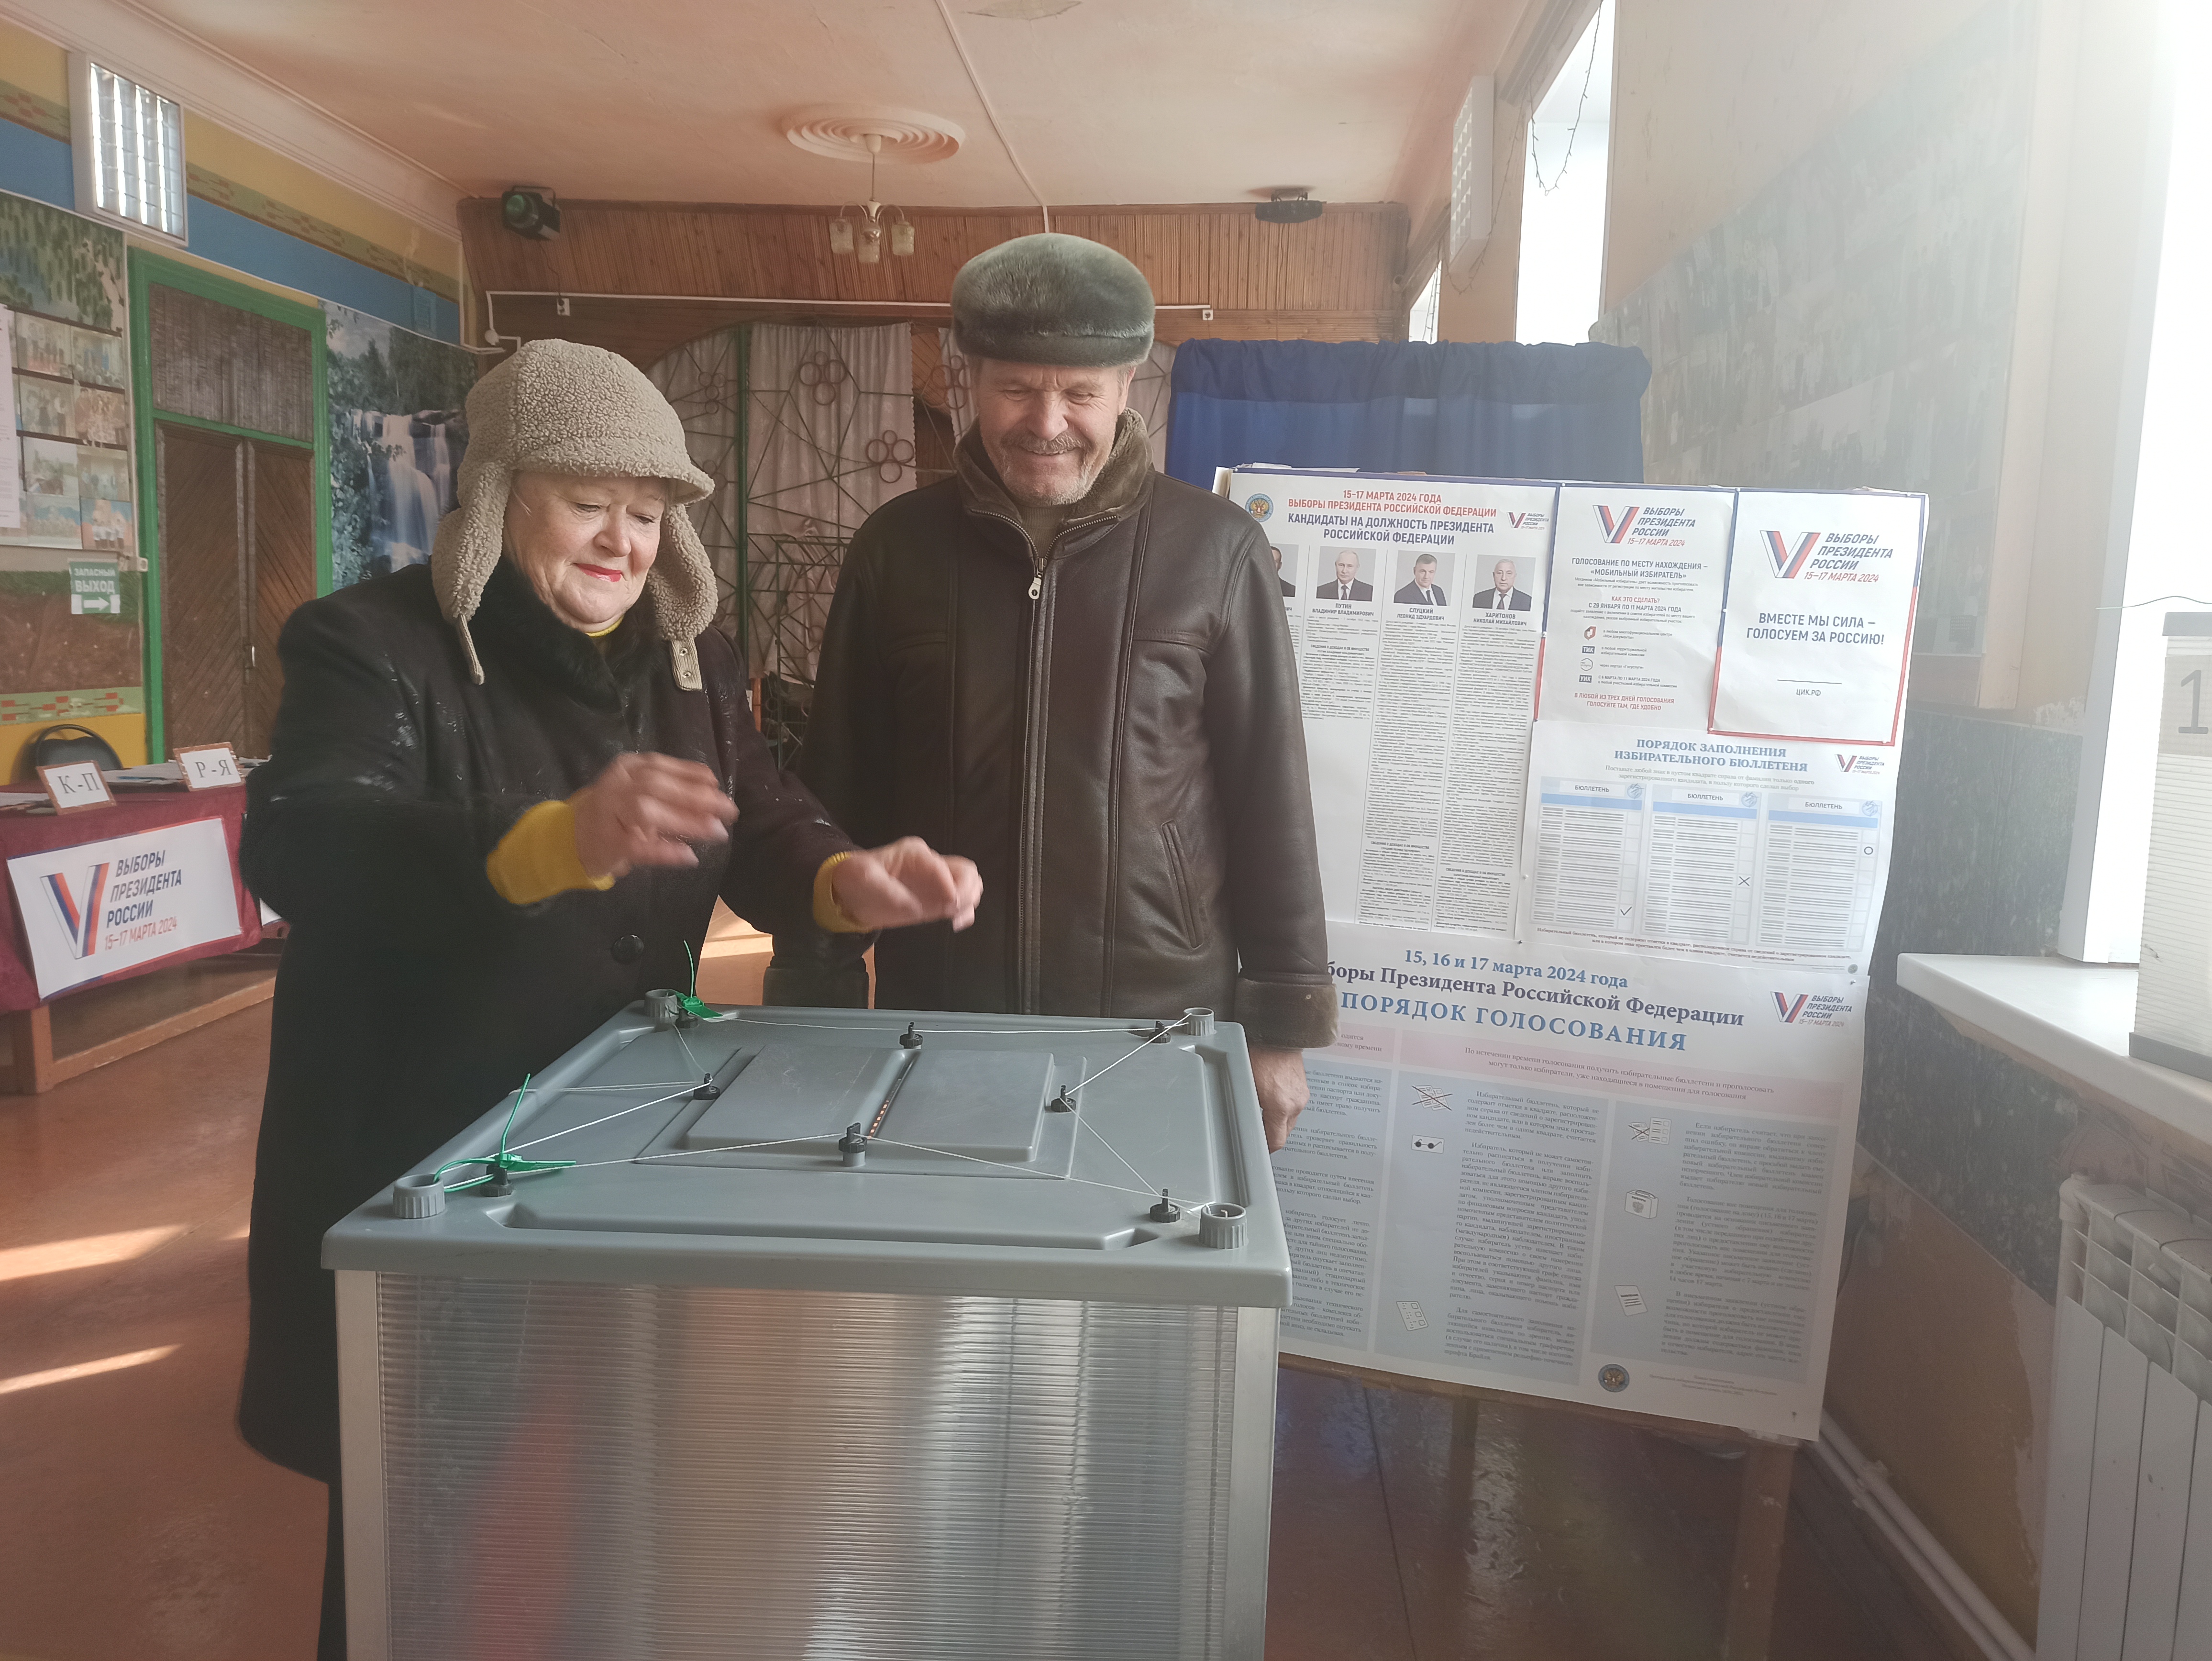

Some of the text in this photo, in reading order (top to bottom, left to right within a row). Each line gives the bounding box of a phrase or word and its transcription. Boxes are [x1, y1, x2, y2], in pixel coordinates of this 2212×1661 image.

[1366, 491, 1394, 500] МАРТА
[1397, 493, 1416, 501] 2024
[1419, 494, 1441, 503] ГОДА
[1289, 499, 1496, 518] ВЫБОРЫ ПРЕЗИДЕНТА РОССИЙСКОЙ ФЕДЕРАЦИИ
[1643, 507, 1685, 516] ВЫБОРЫ
[1288, 513, 1494, 533] КАНДИДАТЫ НА ДОЛЖНОСТЬ ПРЕЗИДЕНТА
[1637, 518, 1696, 527] ПРЕЗИДЕНТА
[1324, 529, 1454, 545] РОССИЙСКОЙ ФЕДЕРАЦИИ
[1632, 528, 1670, 537] РОССИИ
[1825, 533, 1879, 544] ВЫБОРЫ
[1818, 546, 1893, 558] ПРЕЗИДЕНТА
[1572, 558, 1619, 566] ГОЛОСОВАНИЕ
[1810, 559, 1859, 570] РОССИИ
[74, 568, 115, 576] ЗАПАСНЫЙ
[1591, 569, 1638, 577] «МОБИЛЬНЫЙ
[1827, 573, 1857, 582] МАРТА
[1858, 574, 1879, 582] 2024
[75, 580, 115, 594] ВЫХОД
[1759, 613, 1804, 625] ВМЕСТЕ
[1808, 615, 1829, 626] МЫ
[1833, 616, 1864, 628] СИЛА
[1747, 628, 1884, 644] ГОЛОСУЕМ ЗА РОССИЮ!
[2178, 669, 2209, 734] 1
[1637, 739, 1786, 757] ПОРЯДОК ЗАПОЛНЕНИЯ
[1615, 751, 1808, 772] ИЗБИРАТЕЛЬНОГО БЮЛЛЕТЕНЯ
[116, 850, 166, 877] ВЫБОРЫ
[110, 869, 182, 903] ПРЕЗИДЕНТА
[107, 900, 153, 928] РОССИИ
[129, 921, 156, 943] МАРТА
[158, 916, 177, 935] 2024
[1405, 950, 1628, 989] 15, 16 и 17 марта 2024 года
[1327, 961, 1745, 1027] боры Президента Российской Федерации
[1811, 995, 1844, 1003] ВЫБОРЫ
[1802, 1011, 1833, 1019] РОССИИ
[1807, 1003, 1852, 1012] ПРЕЗИДЕНТА
[1341, 992, 1687, 1051] ПОРЯДОК ГОЛОСОВАНИЯ
[1476, 1050, 1511, 1060] истечении
[1513, 1054, 1540, 1064] времени
[1542, 1058, 1585, 1070] голосования
[1587, 1063, 1619, 1074] получить
[1621, 1068, 1674, 1083] избирательные
[1675, 1076, 1714, 1087] бюллетени
[1723, 1082, 1774, 1095] проголосовать
[1488, 1060, 1508, 1068] могут
[1510, 1063, 1532, 1071] только
[1534, 1066, 1575, 1078] избиратели,
[1592, 1075, 1637, 1087] находящиеся
[1645, 1082, 1685, 1093] помещении
[1702, 1090, 1746, 1100] голосования
[1477, 1091, 1523, 1102] Избирательный
[1563, 1104, 1589, 1113] который
